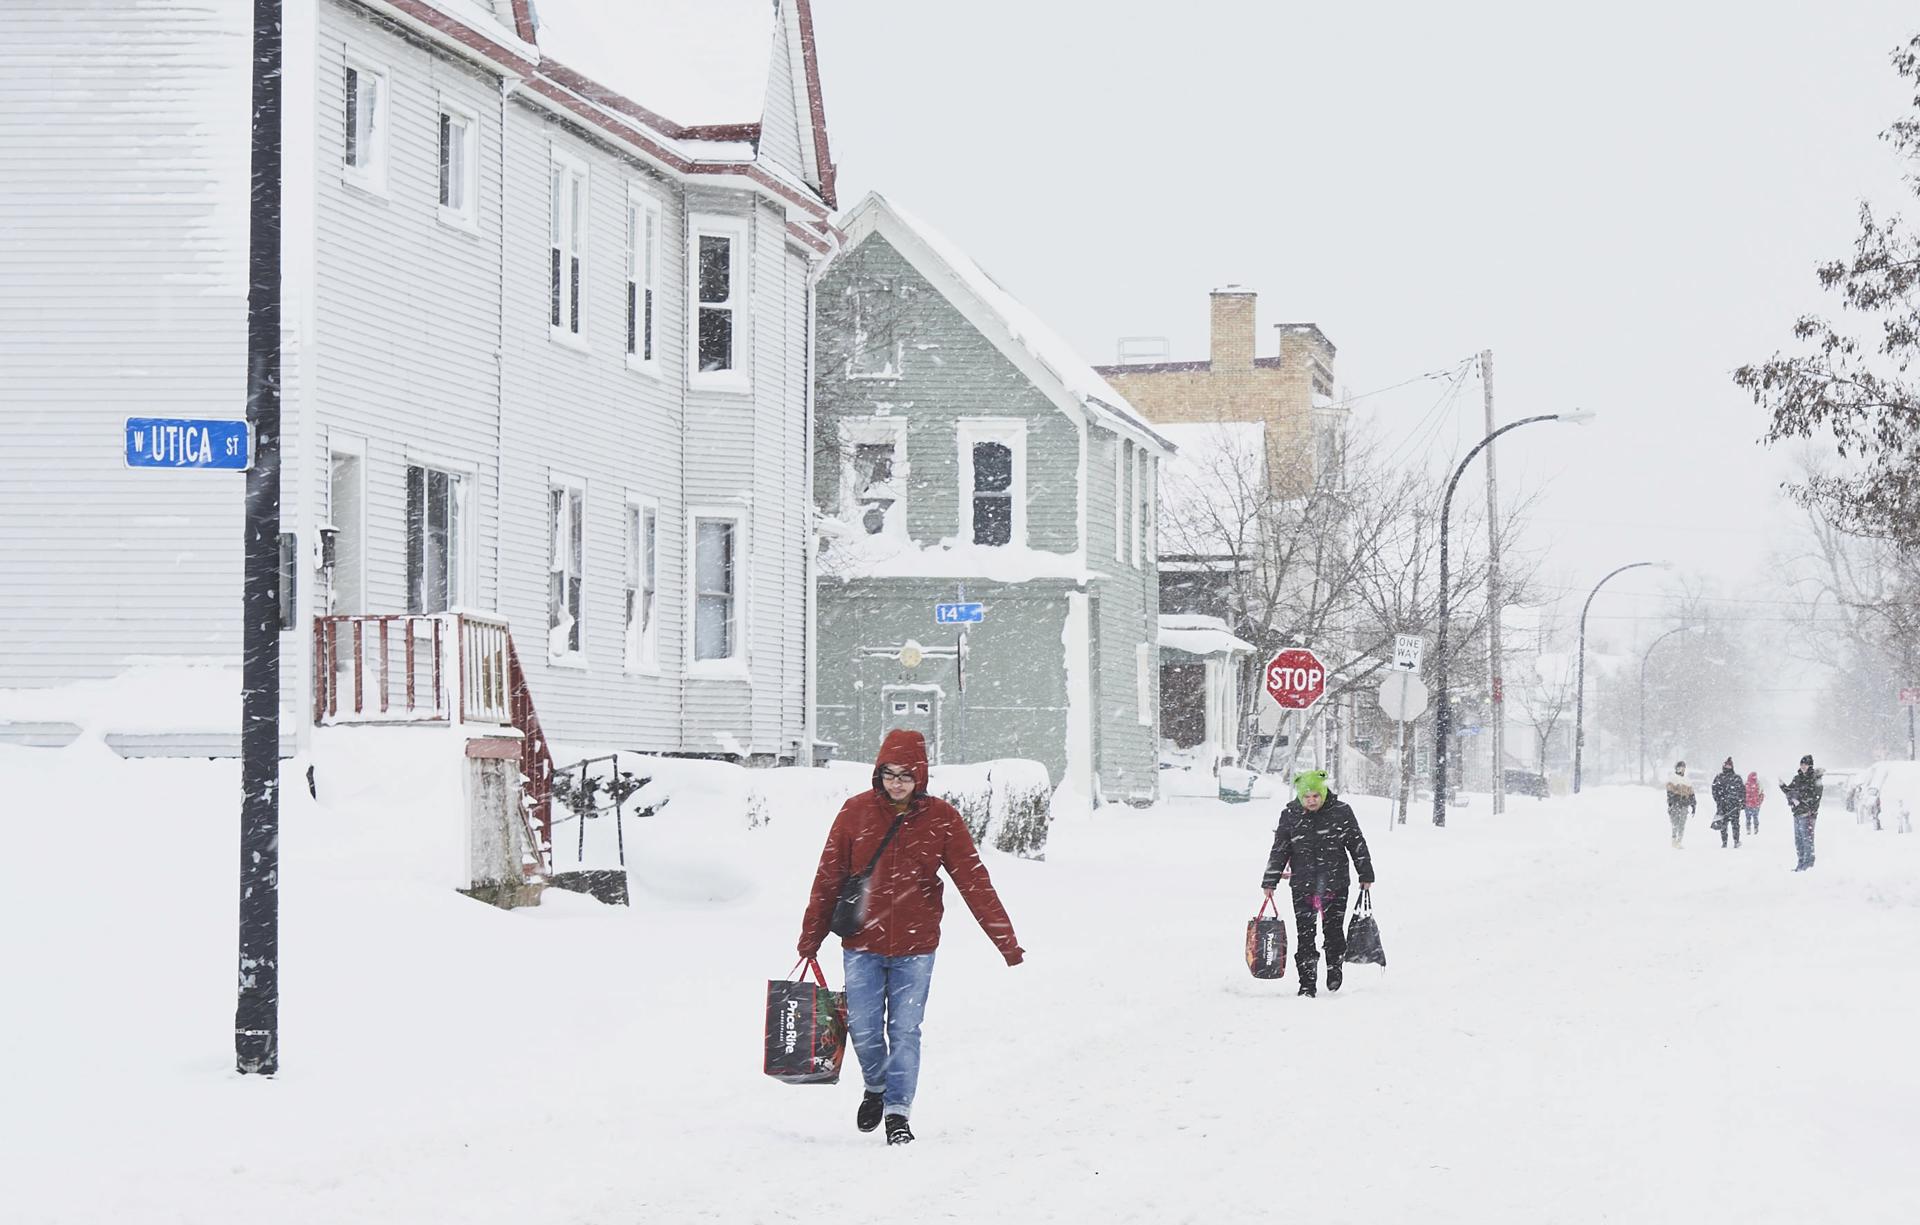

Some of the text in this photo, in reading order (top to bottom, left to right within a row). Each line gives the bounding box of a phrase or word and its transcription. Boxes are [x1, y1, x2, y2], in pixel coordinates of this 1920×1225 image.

[134, 425, 239, 463] W UTICA ST
[1399, 637, 1421, 649] ONE
[1397, 648, 1419, 659] WAY
[1269, 667, 1322, 691] STOP
